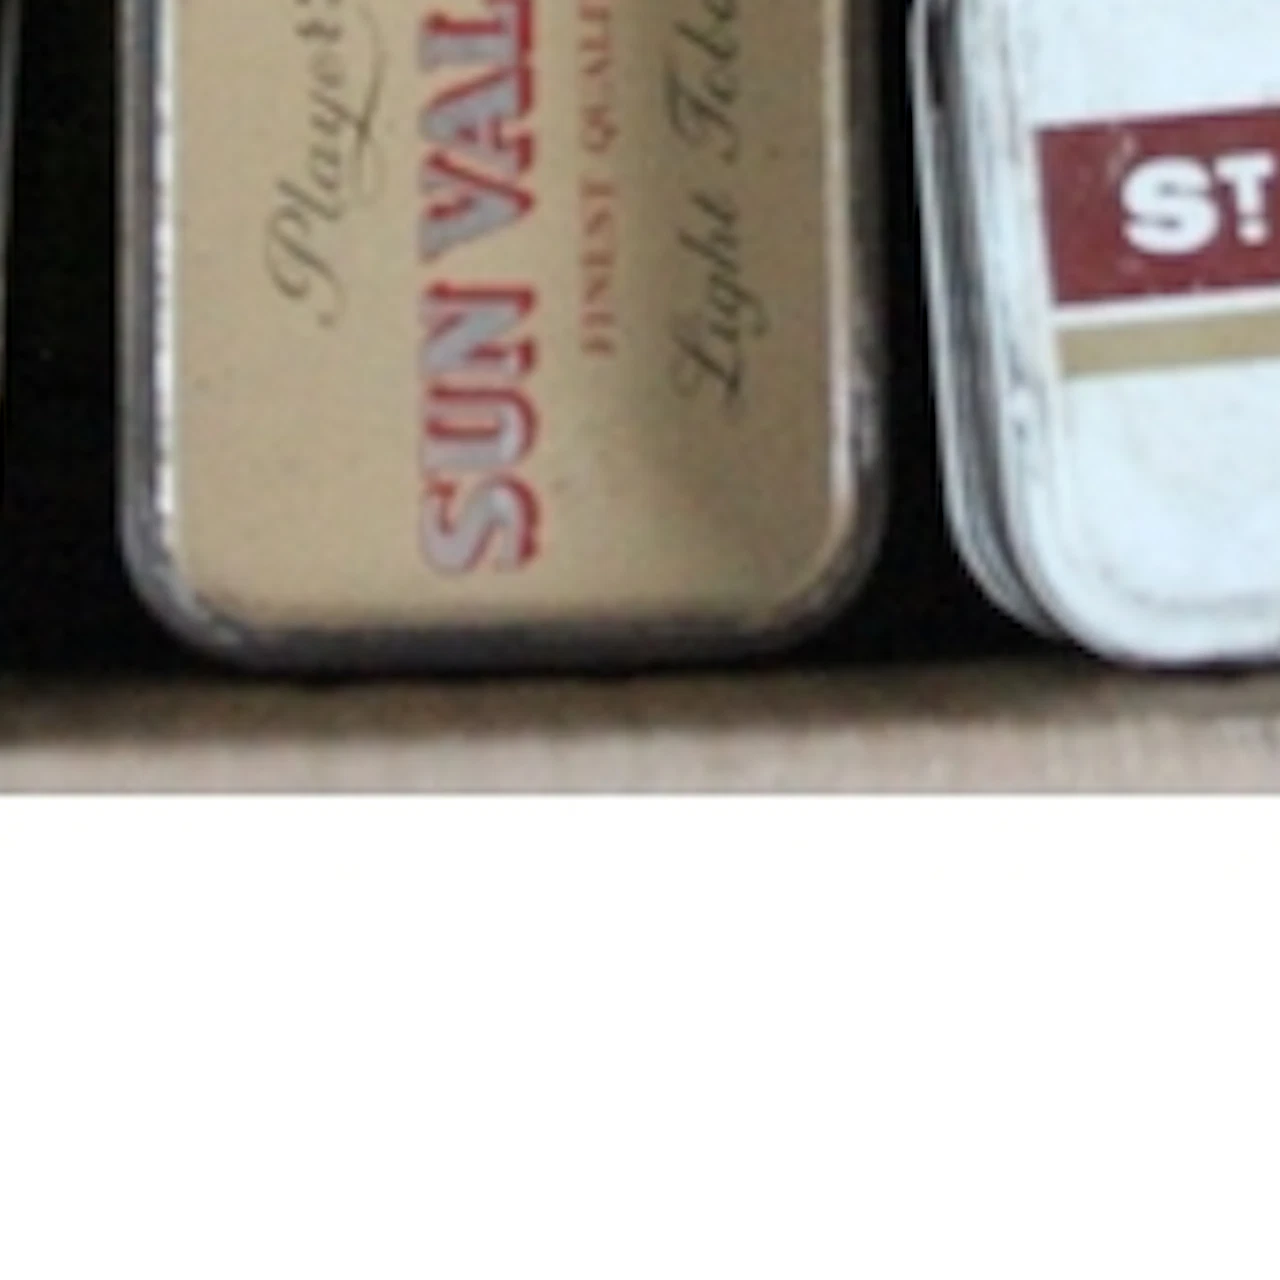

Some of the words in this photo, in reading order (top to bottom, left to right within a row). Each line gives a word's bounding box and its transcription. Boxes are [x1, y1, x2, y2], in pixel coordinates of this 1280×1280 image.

[580, 173, 619, 360] FINEST
[671, 192, 773, 412] Light
[416, 280, 540, 580] SUN
